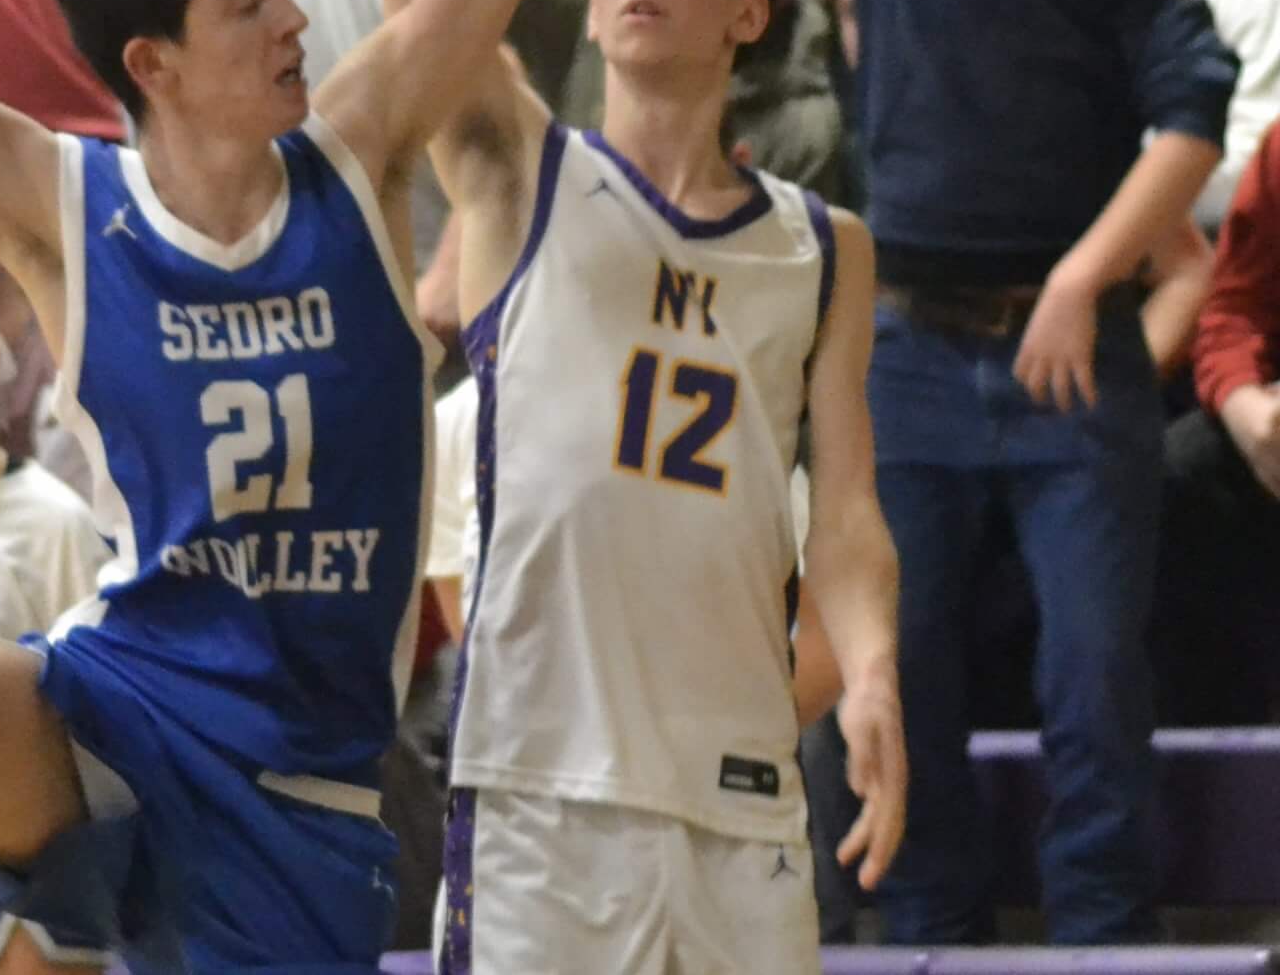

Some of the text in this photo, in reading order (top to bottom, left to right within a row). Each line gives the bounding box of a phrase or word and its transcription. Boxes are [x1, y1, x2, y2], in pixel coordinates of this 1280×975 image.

[158, 286, 336, 362] SEDRO
[199, 373, 313, 523] 21
[612, 343, 741, 499] 12
